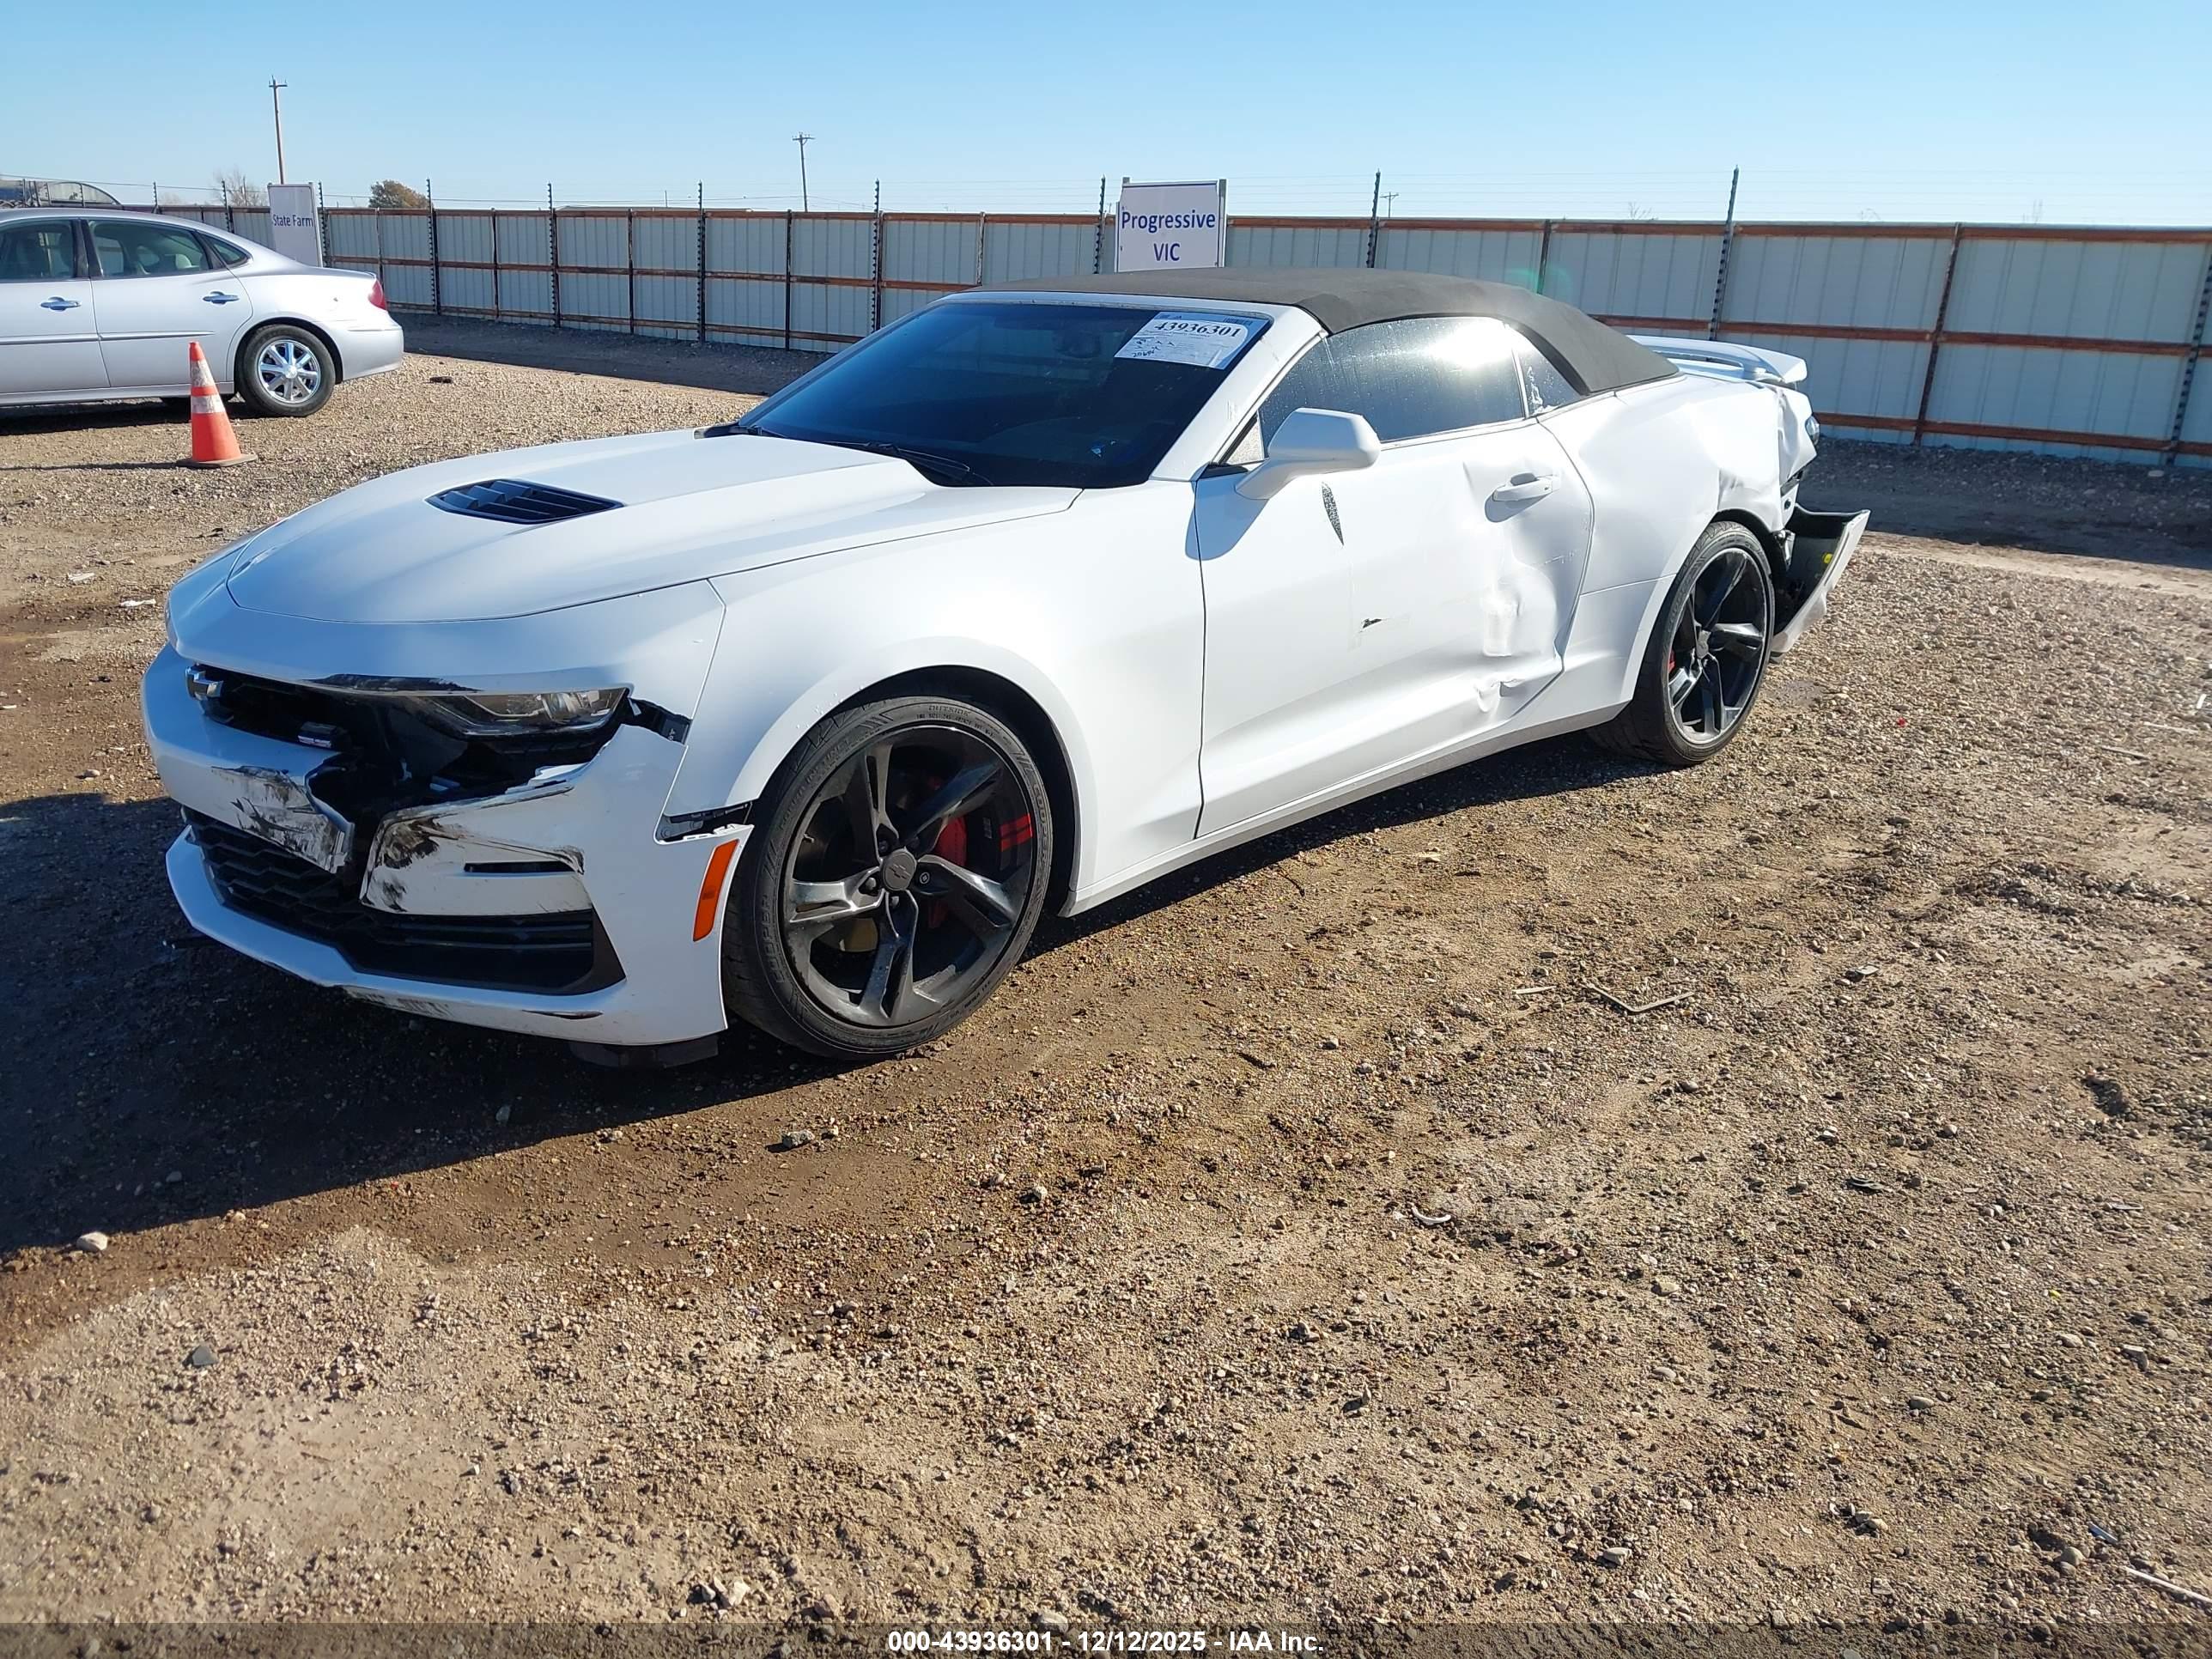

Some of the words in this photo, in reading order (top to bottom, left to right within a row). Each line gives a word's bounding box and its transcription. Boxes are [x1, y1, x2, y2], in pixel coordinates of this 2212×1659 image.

[272, 214, 291, 227] State
[292, 214, 314, 228] Farm
[1121, 209, 1216, 234] Progressive
[1153, 242, 1181, 262] VIC
[1153, 320, 1242, 338] 43936301
